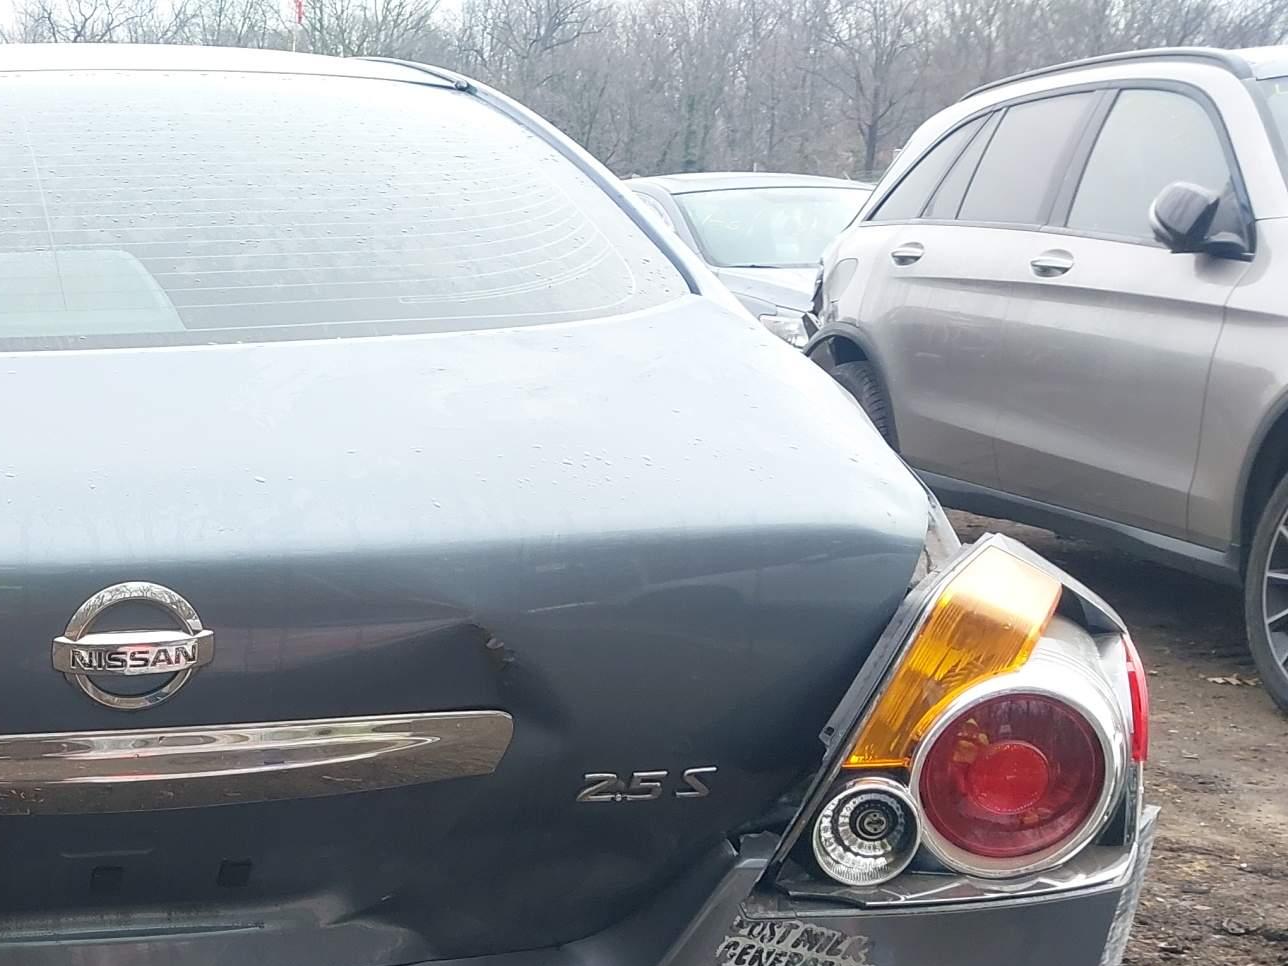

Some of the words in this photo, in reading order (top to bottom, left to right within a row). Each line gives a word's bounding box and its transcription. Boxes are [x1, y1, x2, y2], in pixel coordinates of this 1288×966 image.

[70, 642, 198, 670] NISSAN
[576, 766, 668, 802] 2.5
[675, 767, 717, 799] S
